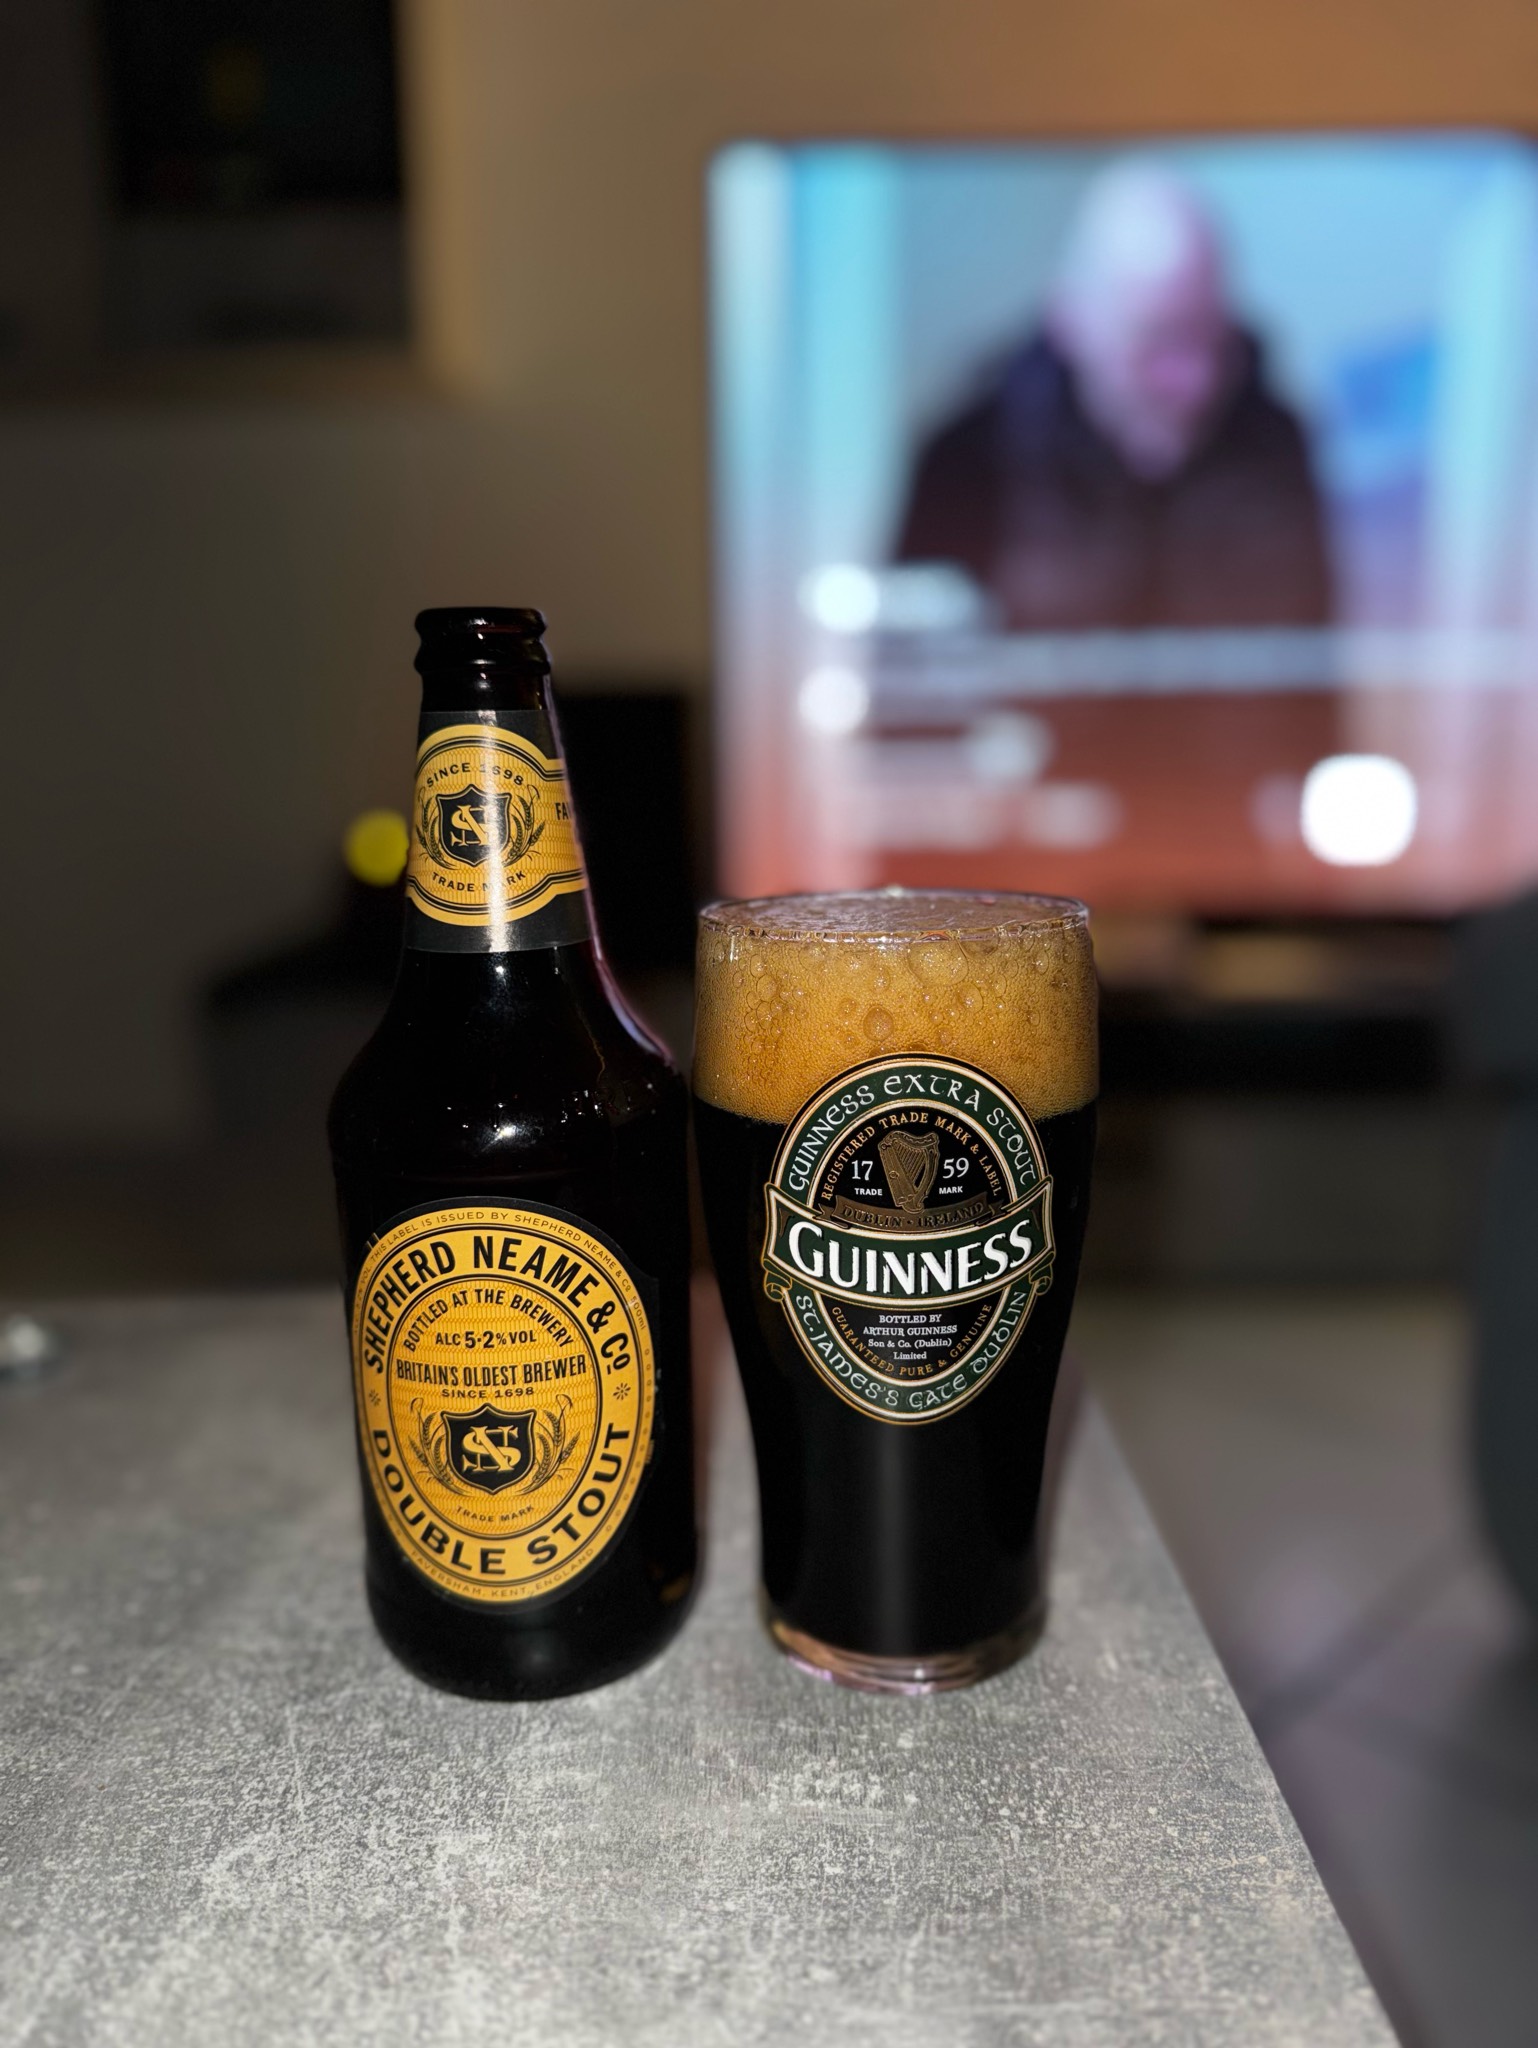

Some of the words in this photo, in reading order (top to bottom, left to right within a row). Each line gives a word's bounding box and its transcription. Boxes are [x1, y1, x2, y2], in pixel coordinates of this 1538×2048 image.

[427, 762, 471, 787] SINCE
[432, 872, 475, 892] TRADE
[788, 1085, 875, 1191] GUINNESS
[883, 1074, 981, 1112] EXTRA
[986, 1107, 1036, 1186] STOUT
[821, 1126, 876, 1201] REGISTERED
[878, 1111, 929, 1129] TRADE
[934, 1116, 972, 1146] MARK
[970, 1143, 980, 1155] &
[978, 1155, 1003, 1197] LABEL
[851, 1159, 874, 1181] 17
[942, 1157, 970, 1179] 59
[854, 1187, 883, 1196] TRADE
[938, 1185, 963, 1195] MARK
[842, 1205, 906, 1227] DUBLIN
[917, 1202, 985, 1227] IRELAND
[370, 1243, 388, 1262] THIS
[388, 1224, 418, 1246] LABEL
[422, 1218, 433, 1227] IS
[436, 1211, 485, 1223] ISSUED
[490, 1212, 509, 1220] BY
[514, 1214, 582, 1241] SHEPHERD
[583, 1239, 616, 1269] NEAME
[615, 1269, 622, 1278] &
[788, 1218, 1033, 1296] GUINNESS
[364, 1240, 456, 1374] SHEPHERD
[473, 1235, 600, 1308] NEAME
[586, 1300, 616, 1335] &
[403, 1299, 449, 1352] BOTTLED
[451, 1290, 469, 1308] AT
[474, 1288, 506, 1305] THE
[510, 1294, 574, 1348] BREWERY
[863, 1326, 905, 1336] ARTHUR
[906, 1325, 958, 1336] GUINNESS
[878, 1314, 927, 1324] BOTTLED
[929, 1314, 942, 1323] BY
[435, 1332, 461, 1346] ALC
[508, 1329, 537, 1345] VOL
[831, 1306, 895, 1373] GUARANTEED
[899, 1364, 934, 1376] PURE
[938, 1359, 947, 1368] &
[950, 1303, 992, 1358] GENUINE
[868, 1338, 885, 1348] Son
[887, 1340, 895, 1348] &
[897, 1339, 912, 1348] Co.
[914, 1338, 952, 1349] (Dublin)
[893, 1351, 927, 1360] Limited
[396, 1358, 459, 1387] BRITAIN'S
[463, 1364, 518, 1387] OLDEST
[522, 1353, 587, 1384] BREWER
[441, 1388, 487, 1399] SINCE
[494, 1386, 535, 1398] 1698
[909, 1373, 968, 1410] GATE
[373, 1430, 506, 1575] DOUBLE
[527, 1422, 630, 1565] STOUT
[456, 1505, 494, 1522] TRADE
[500, 1504, 535, 1522] MARK
[535, 1548, 594, 1591] ENGLAND
